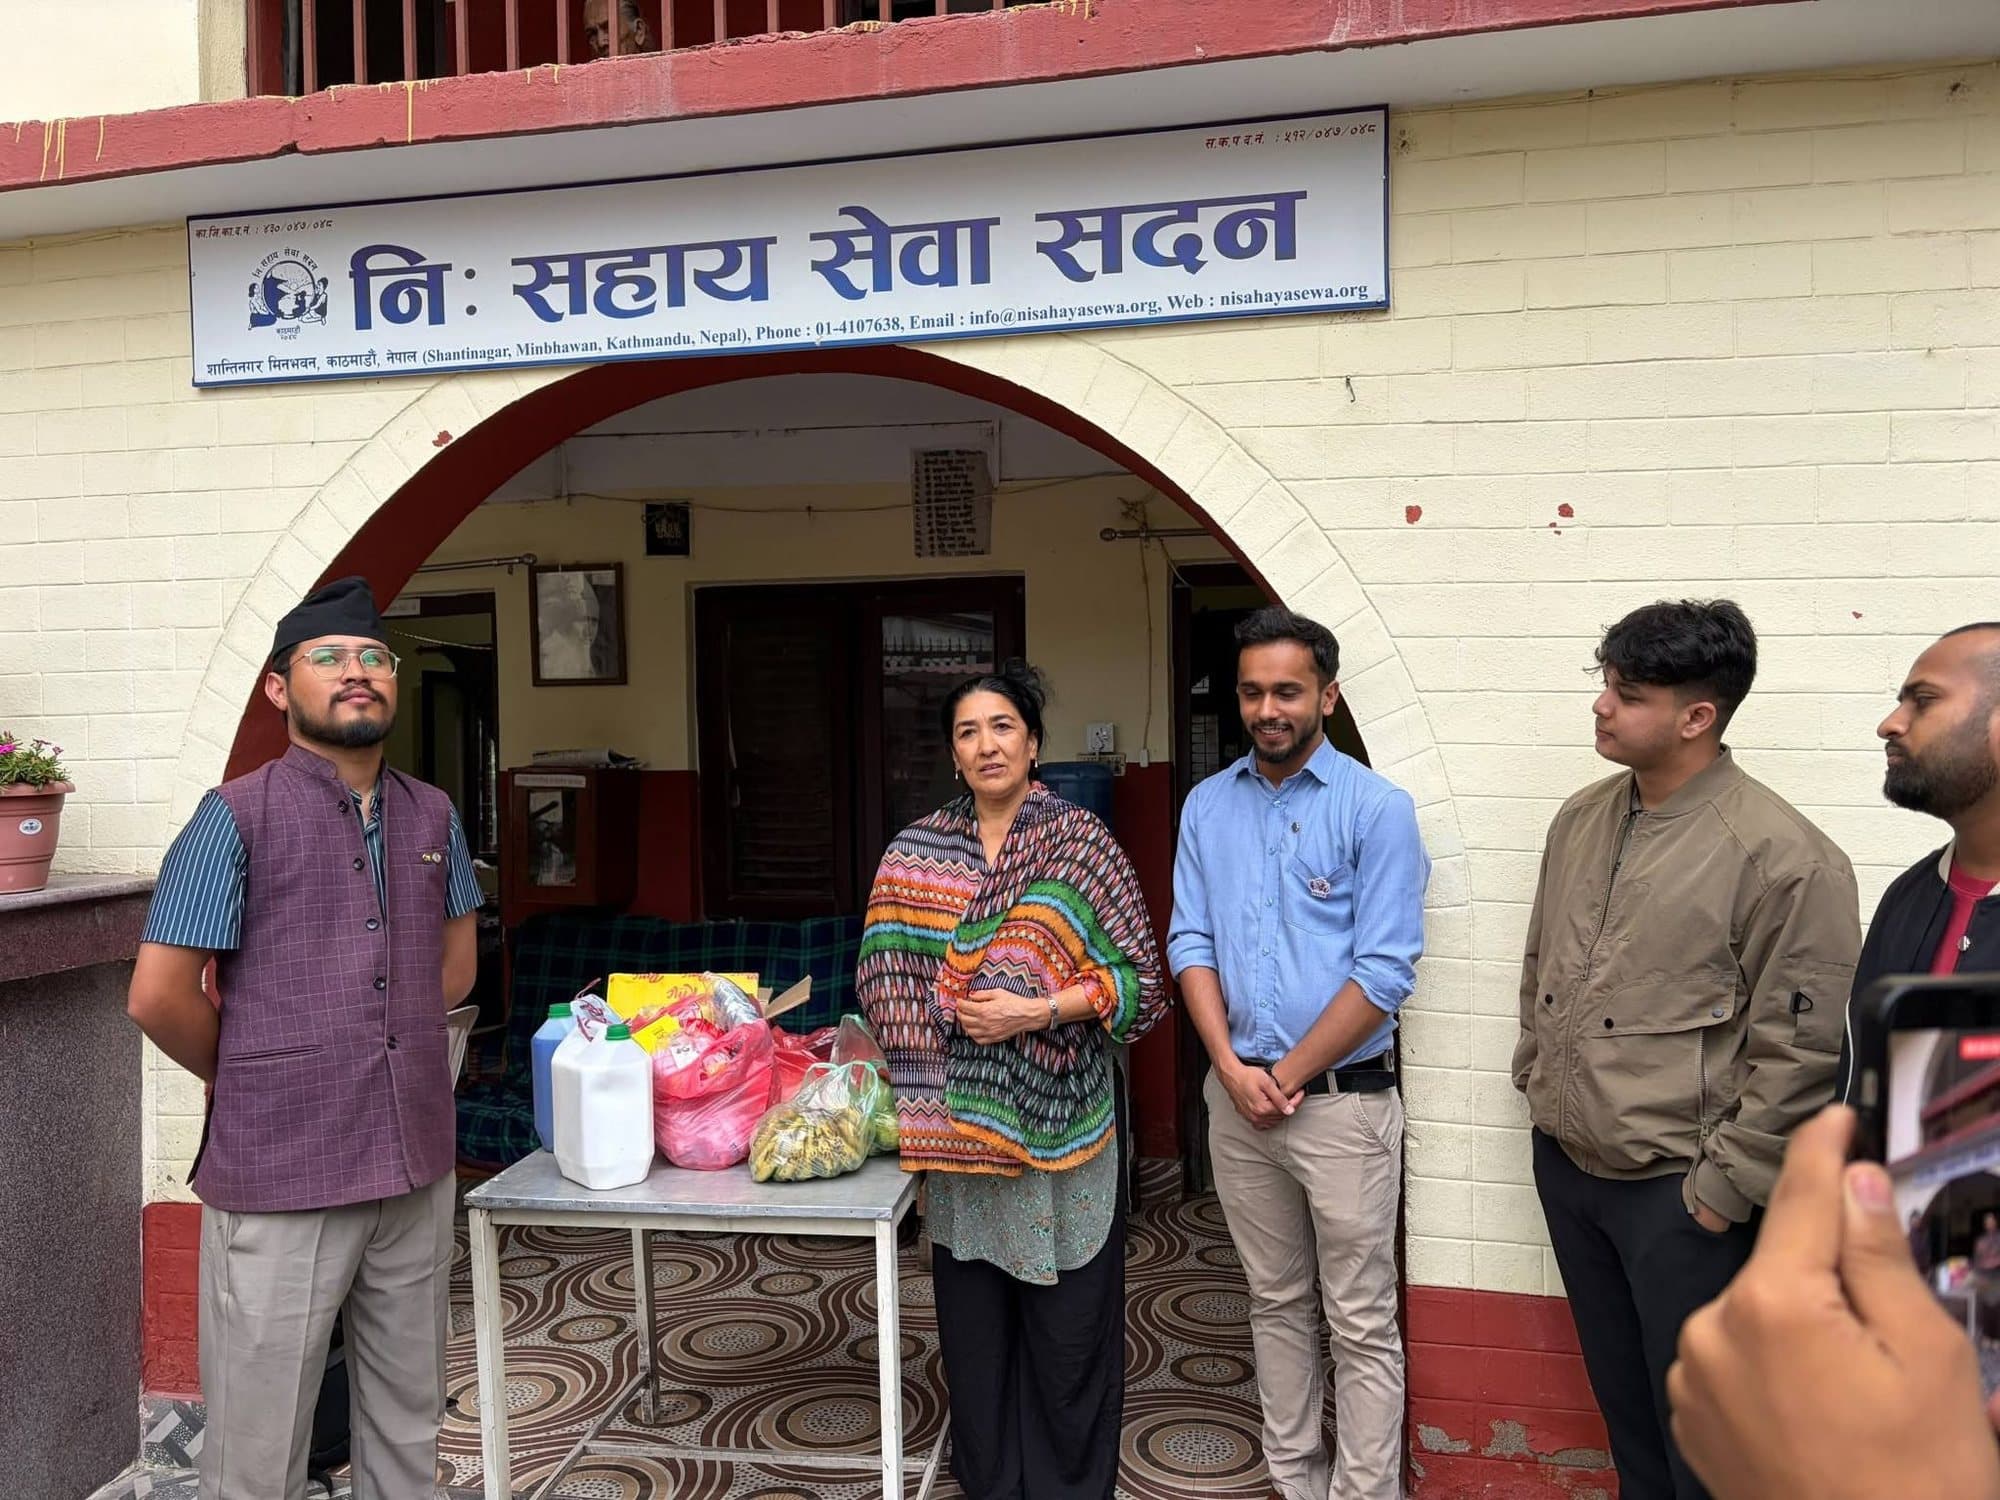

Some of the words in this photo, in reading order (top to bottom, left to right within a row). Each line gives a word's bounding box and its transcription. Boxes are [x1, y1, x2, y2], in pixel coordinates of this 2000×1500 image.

[511, 236, 777, 323] सहाय
[809, 205, 1000, 300] सेवा
[1035, 190, 1307, 283] सदन
[206, 358, 263, 376] शान्तिनगर
[268, 355, 320, 373] मिनभवन,
[386, 349, 417, 365] नेपाल
[422, 345, 512, 365] (Shantinagar,
[516, 338, 602, 357] Minbhawan,
[606, 332, 695, 350] Kathmandu,
[699, 327, 752, 346] Nepal),
[756, 325, 802, 341] Phone
[815, 316, 905, 338] 01-4107638,
[909, 312, 955, 330] Email
[969, 298, 1162, 327] info@nisahayasewa.org,
[1167, 291, 1204, 310] Web
[1220, 284, 1369, 306] nisahayasewa.org
